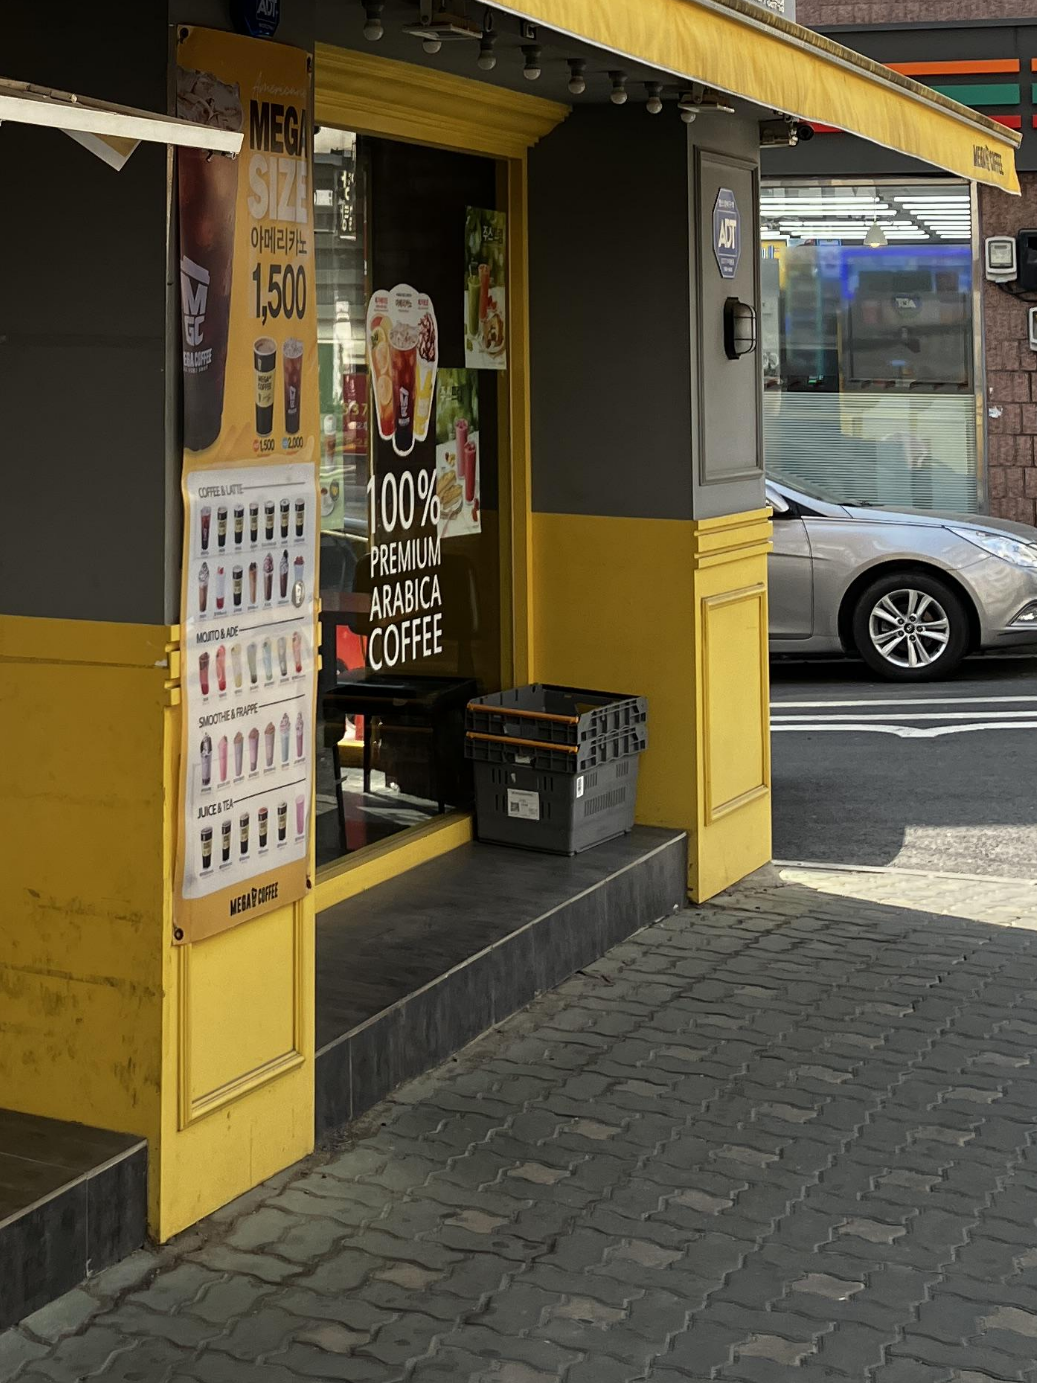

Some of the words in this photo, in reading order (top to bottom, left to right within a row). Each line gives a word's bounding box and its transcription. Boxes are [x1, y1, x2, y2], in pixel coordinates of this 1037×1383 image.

[249, 99, 308, 158] MEGA
[247, 153, 308, 224] SIZE
[251, 226, 307, 256] 아메리카노
[719, 218, 737, 250] ADT
[252, 262, 307, 326] 1,500
[259, 439, 275, 451] 1,500
[288, 437, 303, 449] 2,000
[198, 486, 221, 498] COFFEE
[226, 484, 244, 496] LATTE
[367, 468, 441, 535] 100%
[370, 536, 441, 578] PREMIUM
[369, 574, 442, 622] ARABICA
[196, 628, 220, 644] MOJITO
[226, 625, 239, 638] ADE
[368, 613, 443, 671] COFFEE
[198, 712, 230, 729] SMOOTHIE
[235, 703, 259, 718] FRAPPE
[197, 803, 217, 820] JUICE
[223, 798, 234, 812] TEA
[230, 893, 251, 917] MEGA
[258, 882, 279, 906] COFFEE
